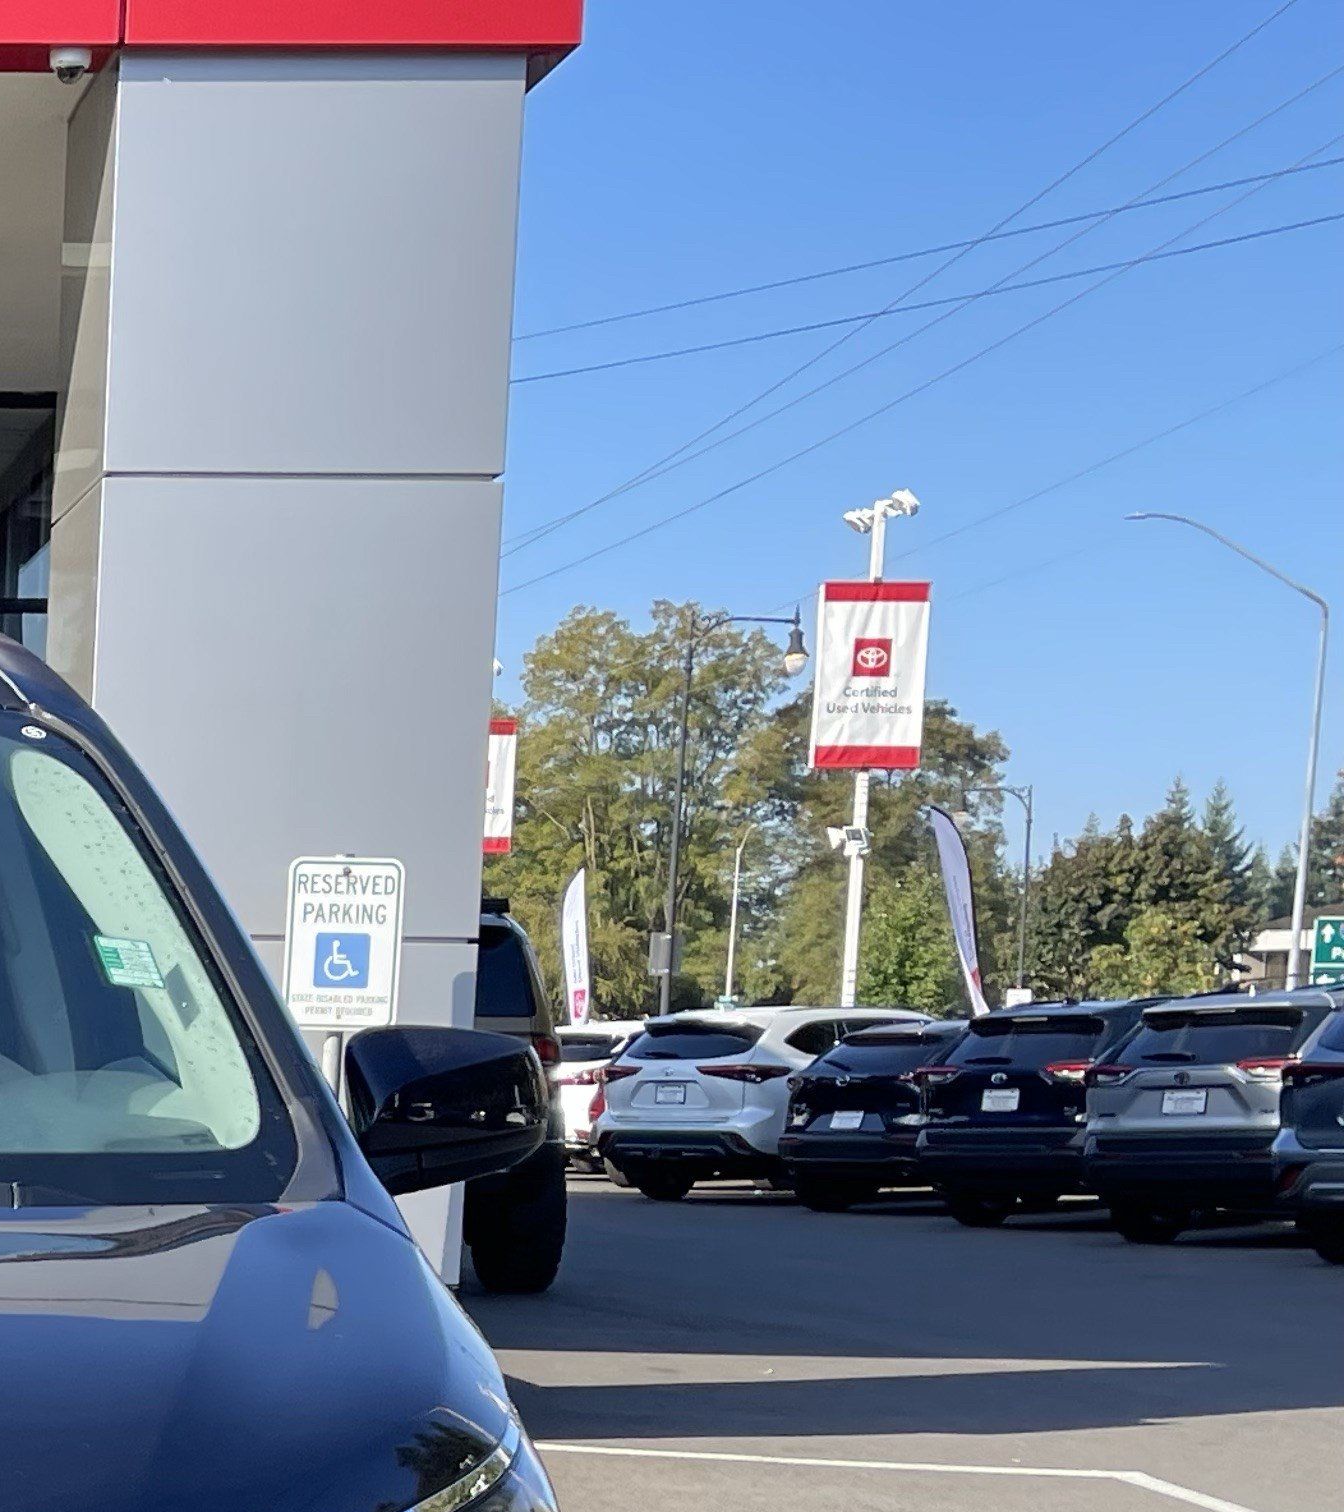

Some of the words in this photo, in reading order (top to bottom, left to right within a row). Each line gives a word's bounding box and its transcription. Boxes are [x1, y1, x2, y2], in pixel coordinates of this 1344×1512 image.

[843, 686, 898, 698] Certified
[826, 703, 859, 714] Used
[861, 703, 913, 714] Vehicles
[297, 873, 396, 896] RESERVED
[302, 903, 387, 925] PARKING
